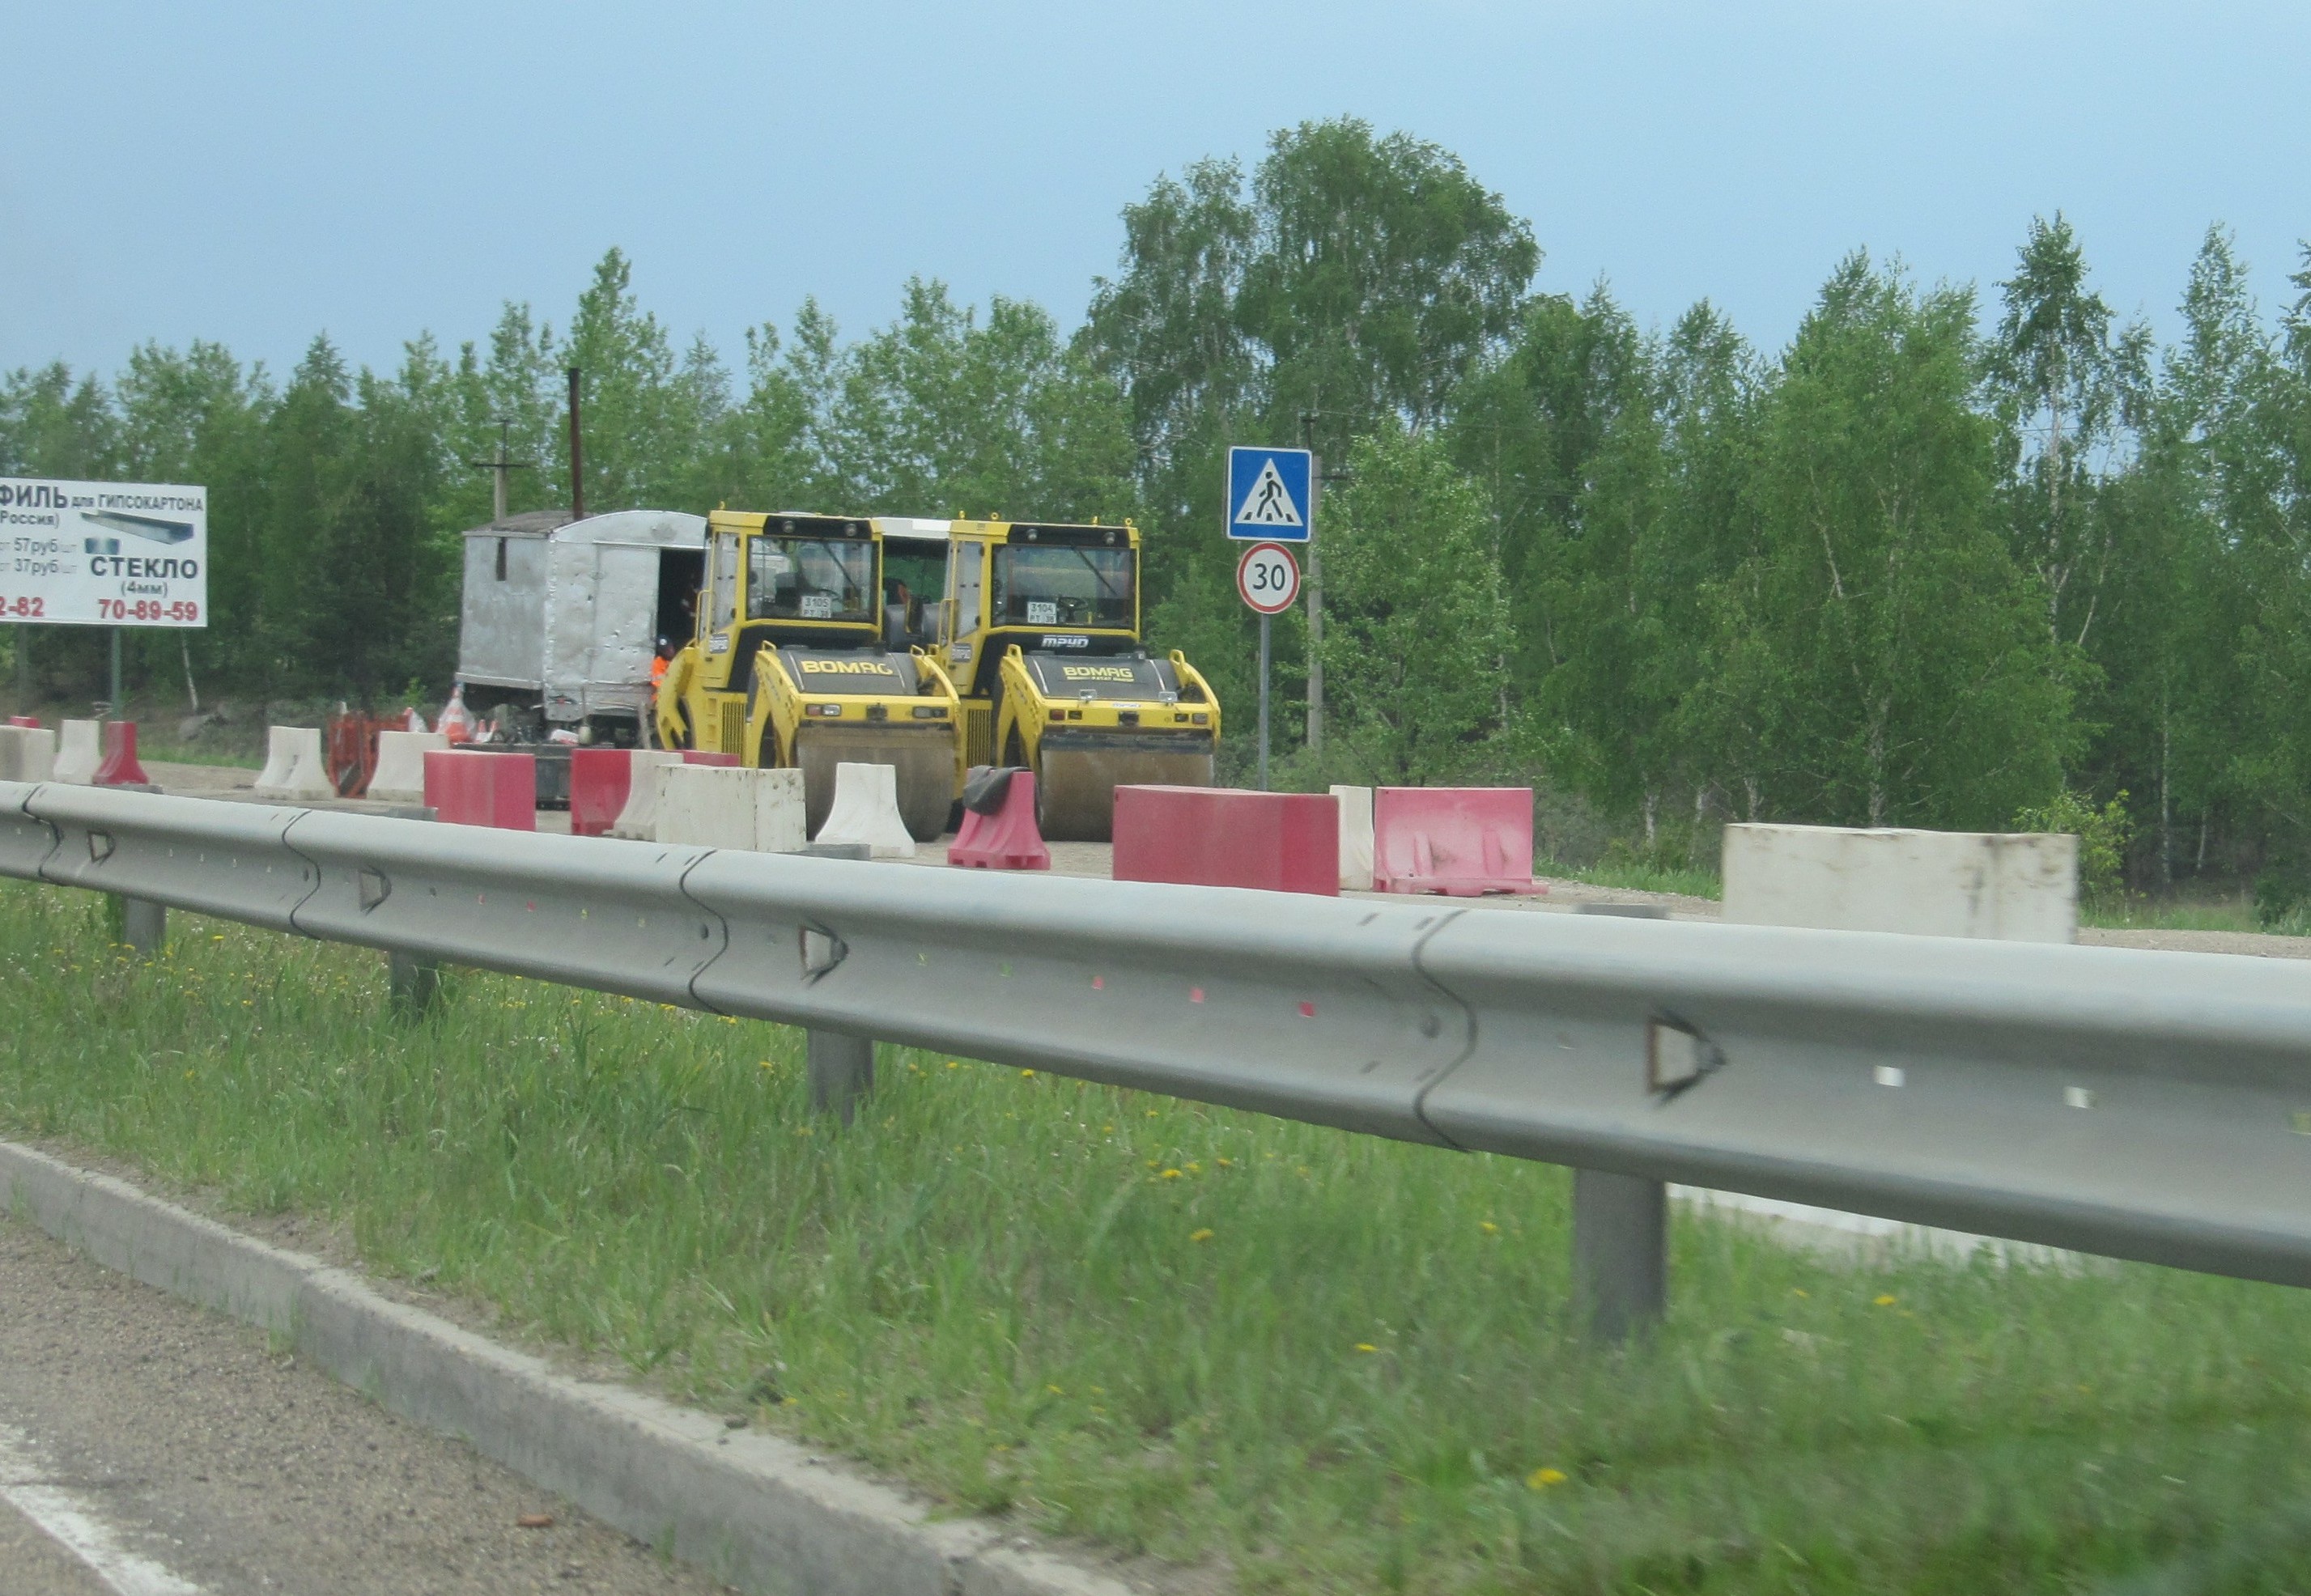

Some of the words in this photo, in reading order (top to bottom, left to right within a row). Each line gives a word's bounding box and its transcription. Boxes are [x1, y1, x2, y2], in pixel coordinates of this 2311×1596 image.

[98, 493, 205, 511] ГИПСОКАРТОНА
[91, 556, 198, 579] СТЕКЛО
[1253, 562, 1285, 591] 30
[121, 580, 168, 598] (4мм)
[97, 598, 198, 622] 70-89-59
[801, 660, 894, 676] BOMAG
[1063, 666, 1134, 678] BOMAG
